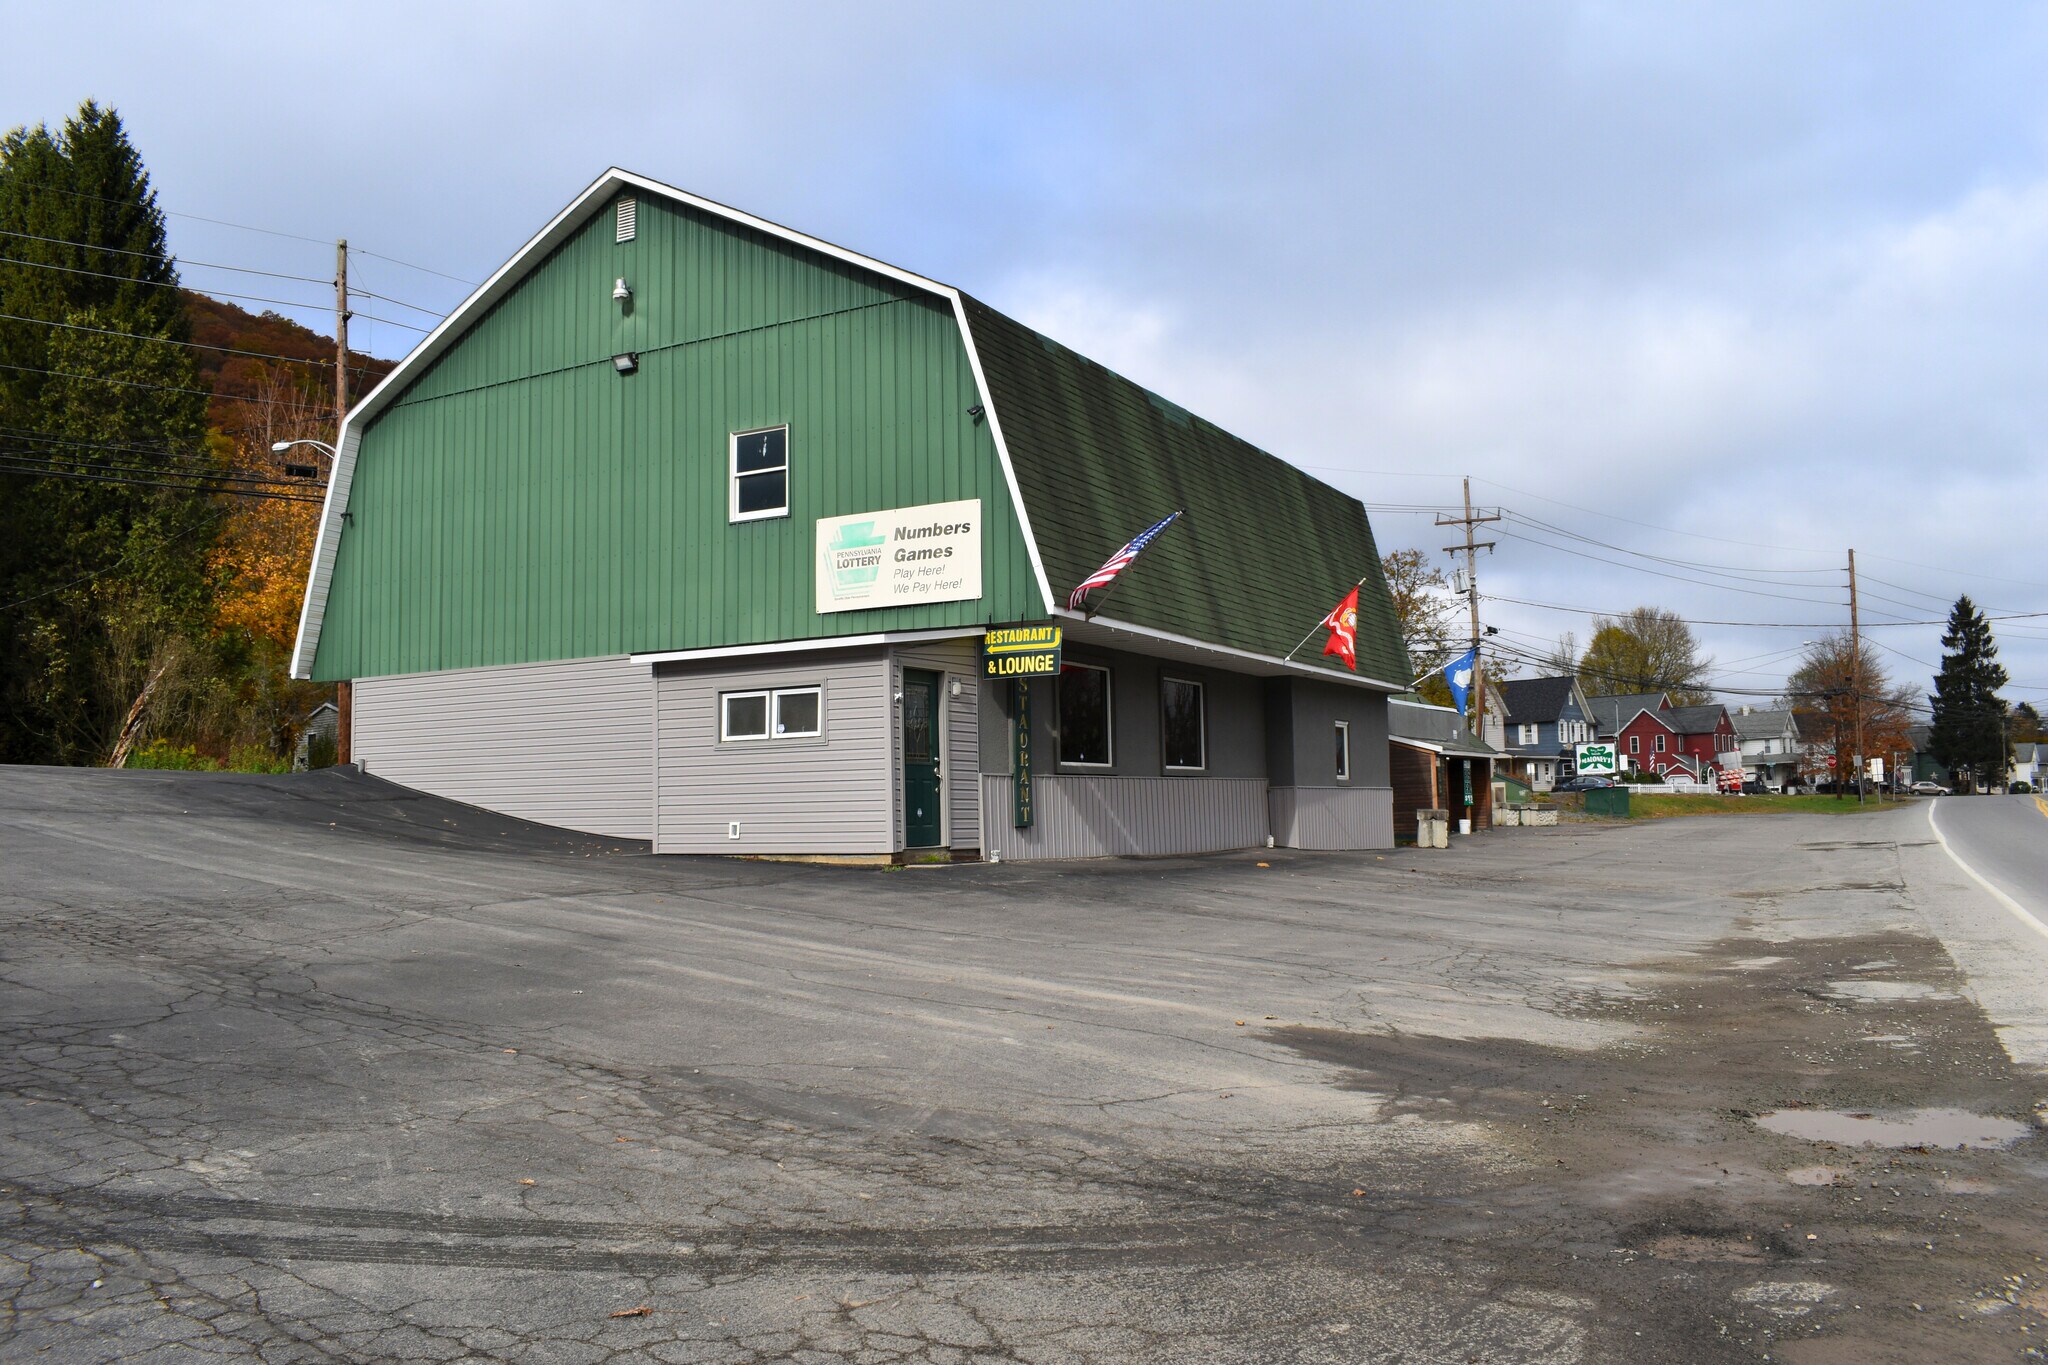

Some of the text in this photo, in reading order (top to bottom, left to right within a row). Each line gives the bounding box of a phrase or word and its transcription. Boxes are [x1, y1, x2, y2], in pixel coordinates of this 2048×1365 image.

[893, 522, 971, 541] Numbers
[836, 547, 882, 559] PENNSYLVANIA
[893, 546, 953, 563] Games
[836, 555, 882, 569] LOTTERY
[893, 564, 946, 581] Play Here!
[893, 578, 963, 594] We Pay Here!
[985, 627, 1053, 645] RESTAURANT
[987, 654, 1054, 675] & LOUNGE
[1018, 677, 1030, 822] STAURANT
